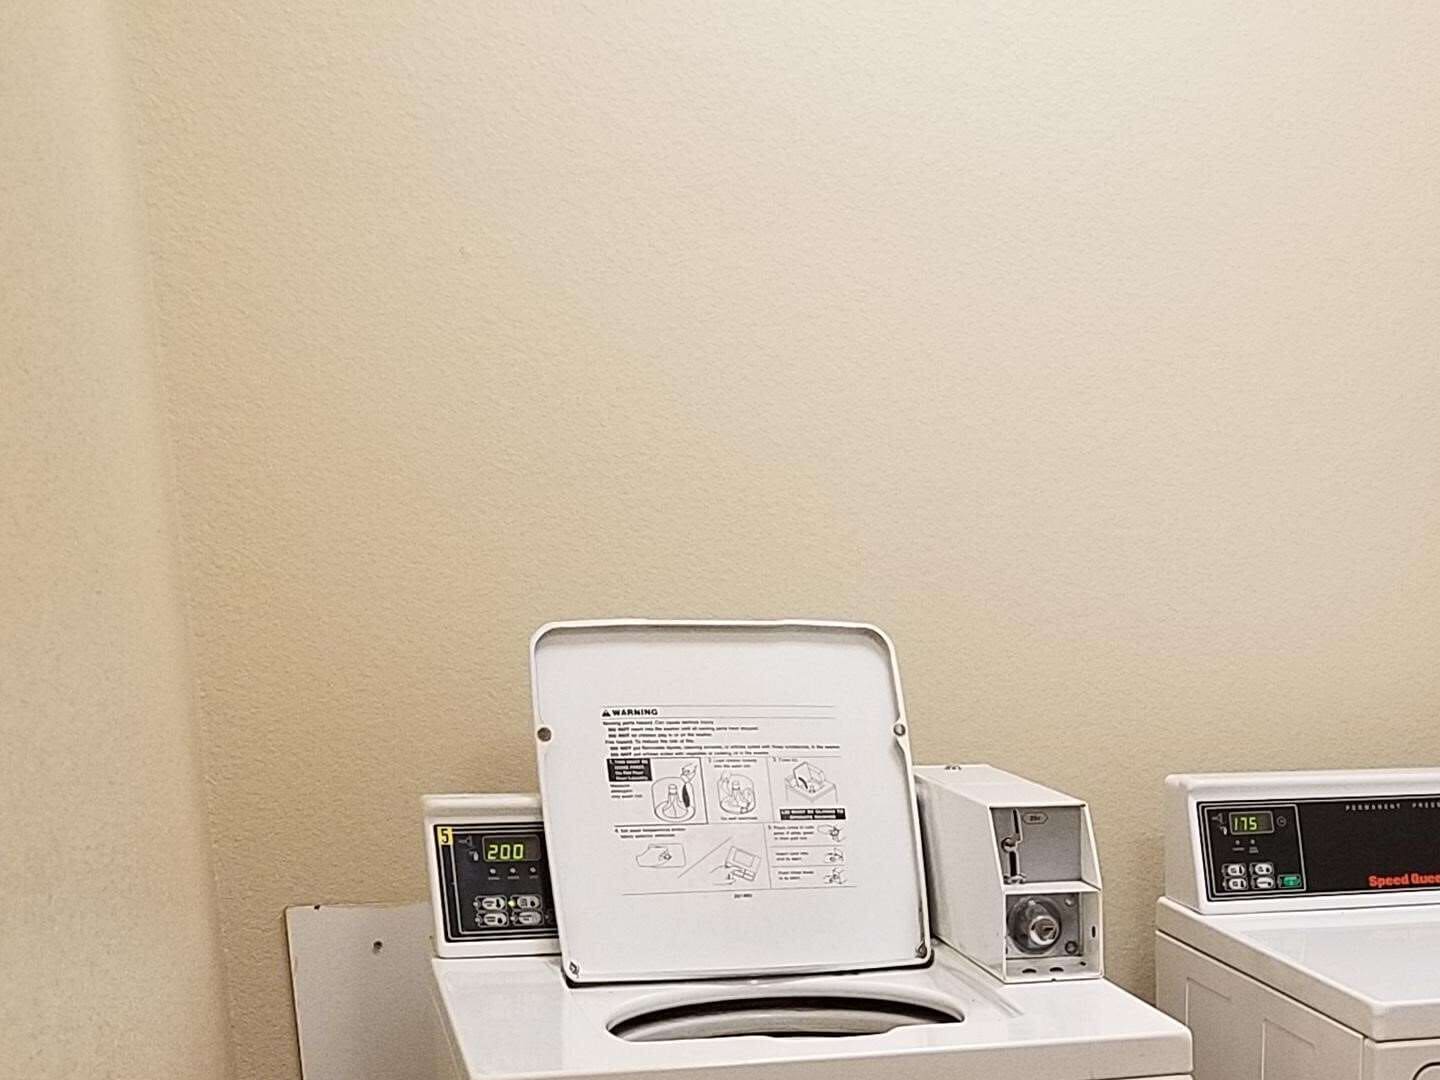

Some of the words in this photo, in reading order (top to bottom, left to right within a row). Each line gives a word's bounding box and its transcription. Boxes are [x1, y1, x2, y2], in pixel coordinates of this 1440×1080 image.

[1234, 816, 1258, 831] 175
[440, 828, 449, 843] 5
[487, 844, 524, 860] 200
[1368, 873, 1409, 888] Speed
